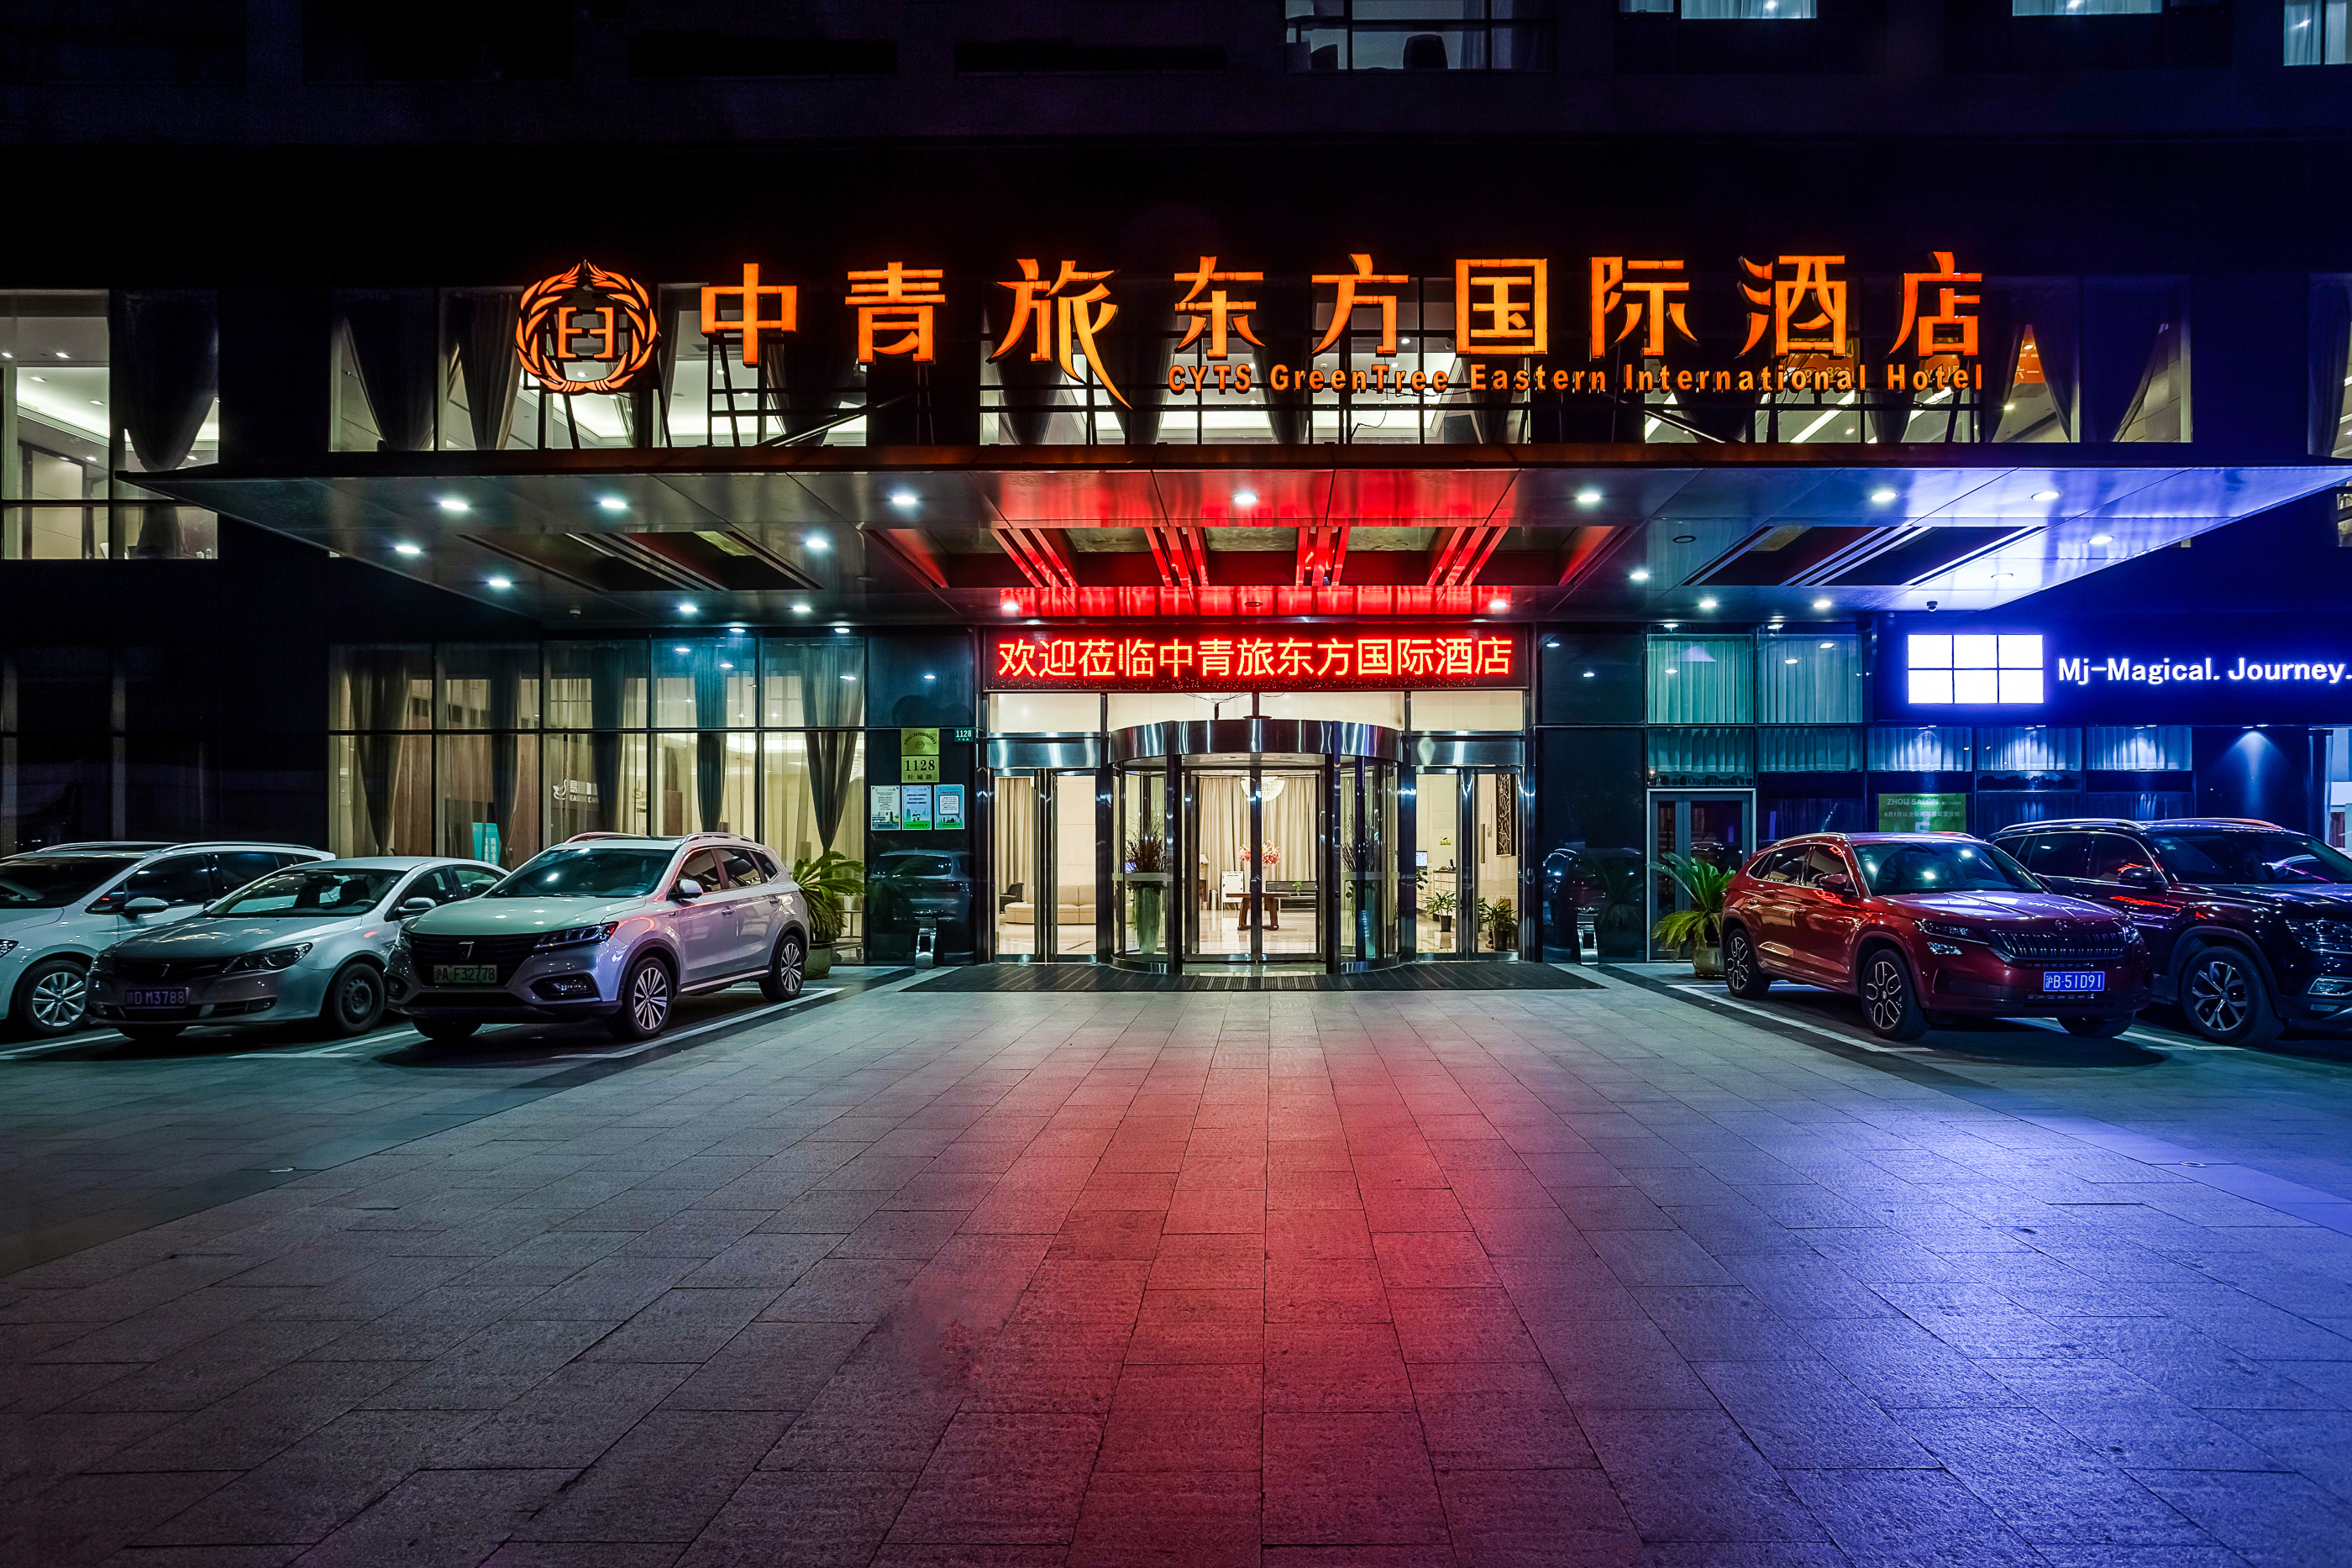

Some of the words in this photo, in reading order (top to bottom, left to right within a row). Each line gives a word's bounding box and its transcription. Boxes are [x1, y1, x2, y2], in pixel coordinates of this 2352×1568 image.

[700, 252, 1983, 410] 中青旅东方国际酒店
[1167, 363, 1252, 394] CYTS
[1269, 364, 1450, 392] GreenTree
[1470, 363, 1606, 391] Eastern
[1625, 363, 1866, 392] International
[1887, 363, 1983, 392] Hotel
[997, 637, 1514, 678] 欢迎莅临中青旅东方国际酒店
[955, 729, 972, 738] 1128
[905, 759, 936, 772] 1128
